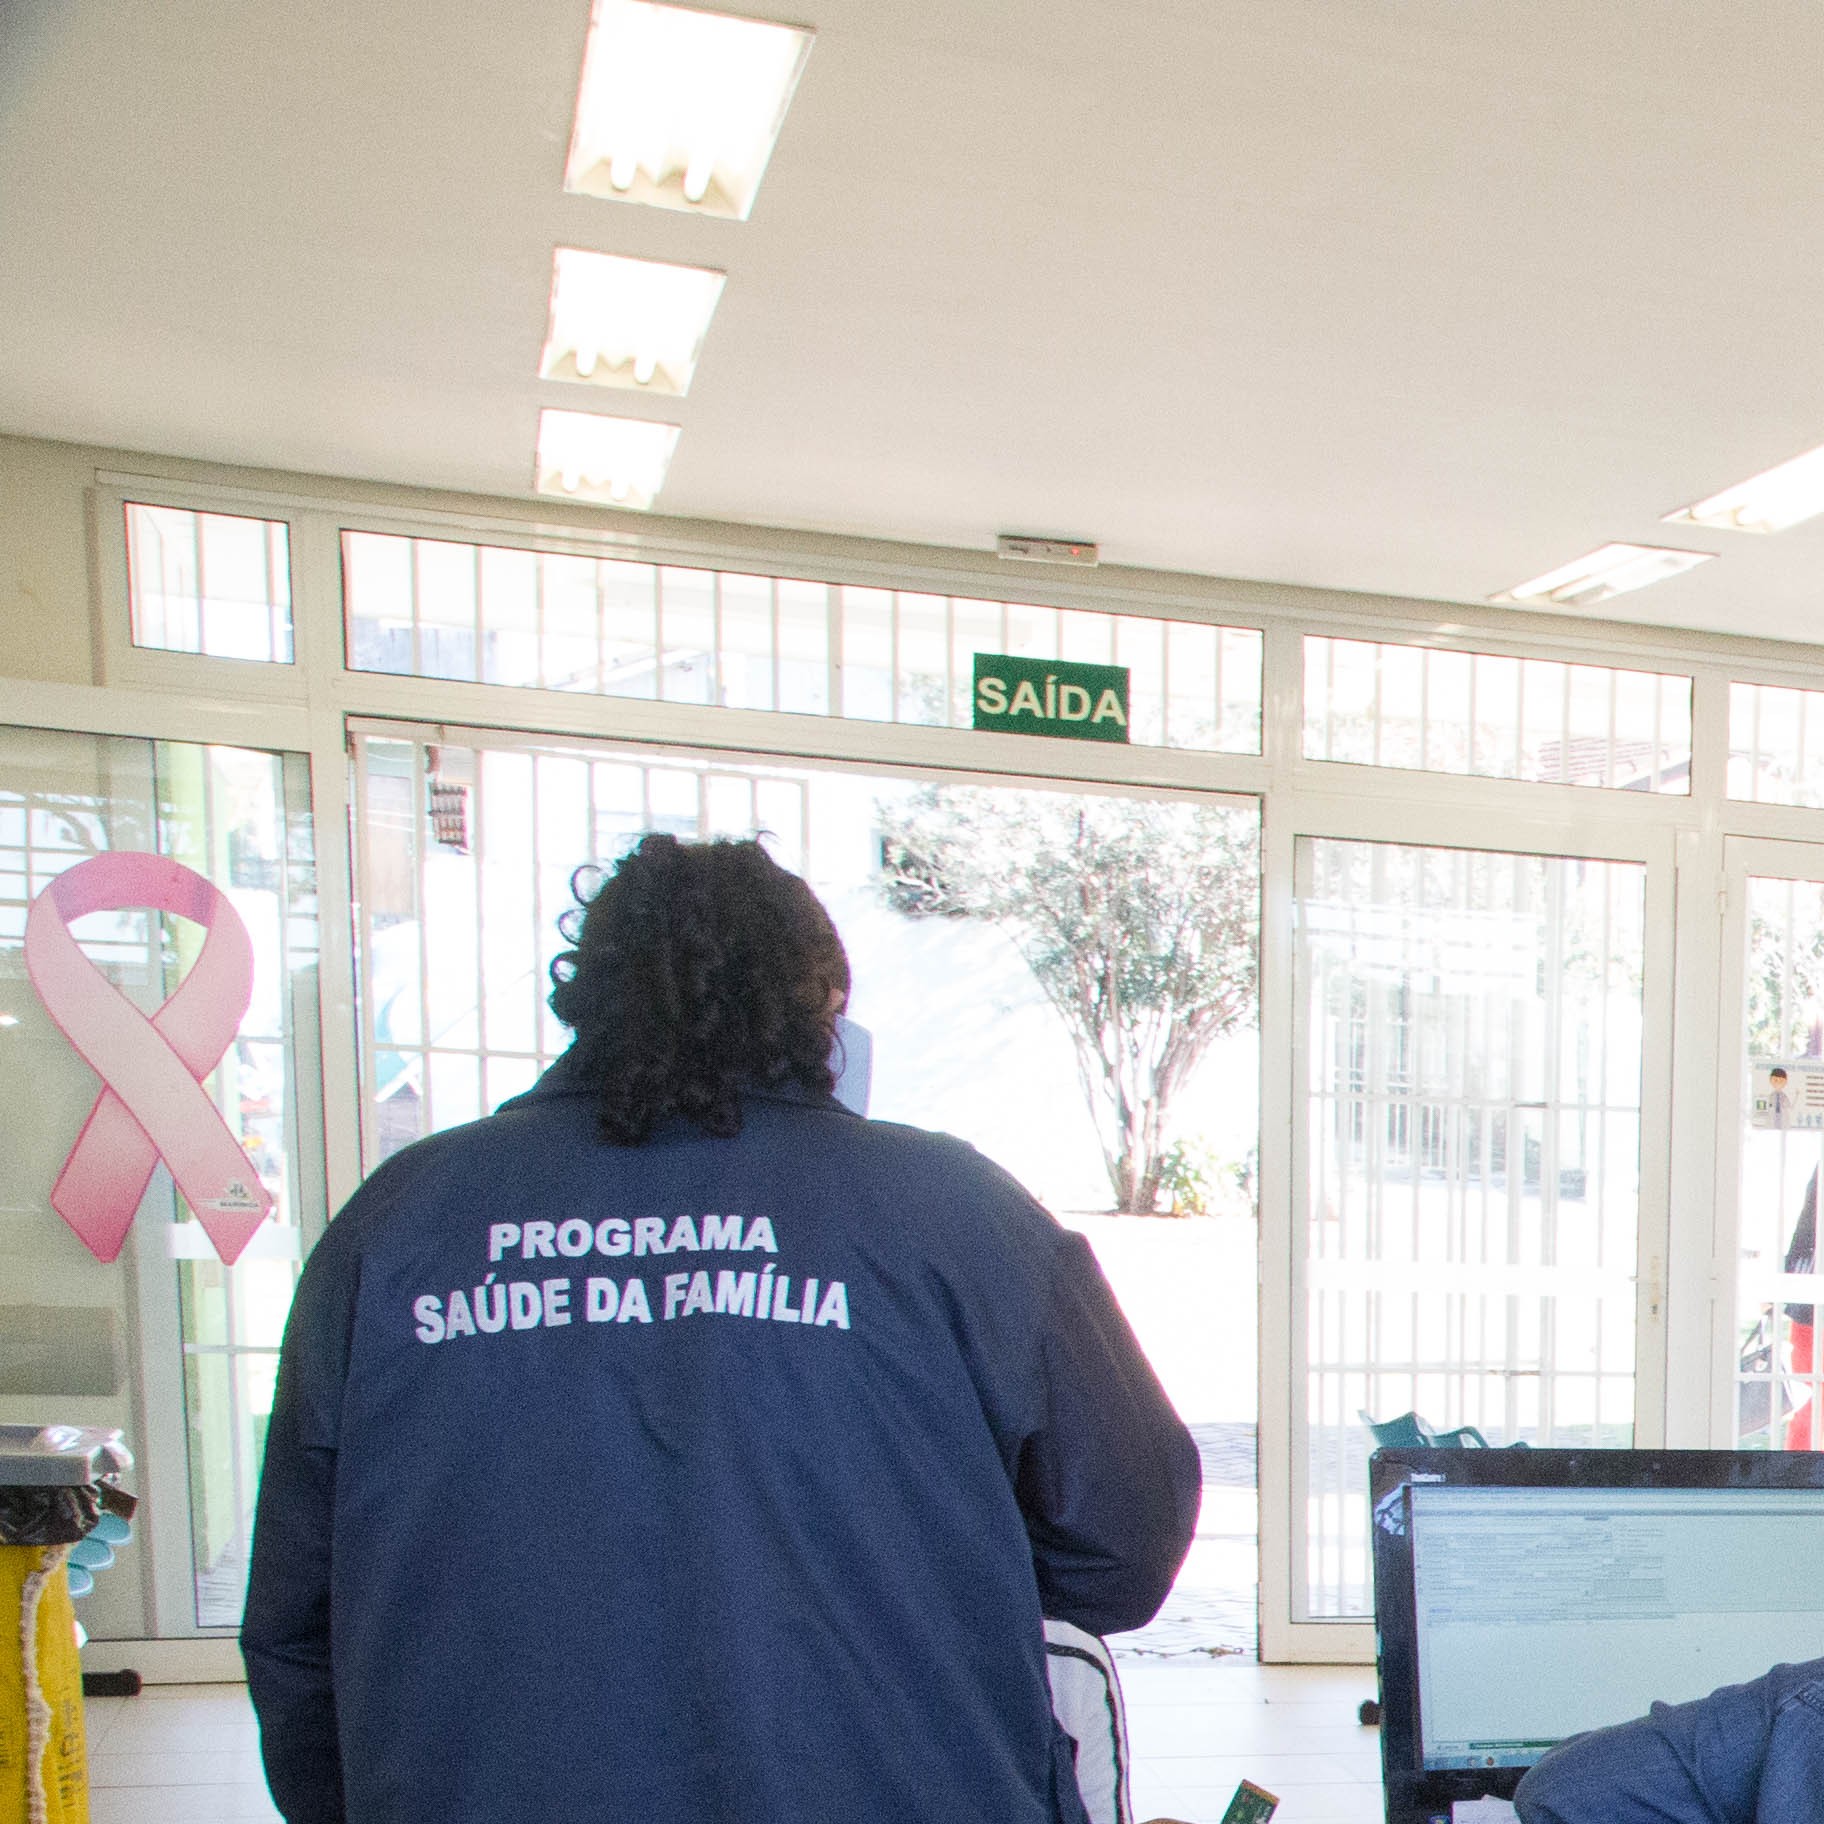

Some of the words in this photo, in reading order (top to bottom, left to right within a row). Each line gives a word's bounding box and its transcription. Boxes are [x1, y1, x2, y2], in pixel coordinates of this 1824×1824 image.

[977, 674, 1127, 726] SAÍDA
[488, 1214, 779, 1262] PROGRAMA
[413, 1273, 572, 1345] SAÚDE
[585, 1276, 654, 1324] DA
[663, 1263, 851, 1330] FAMÍLIA
